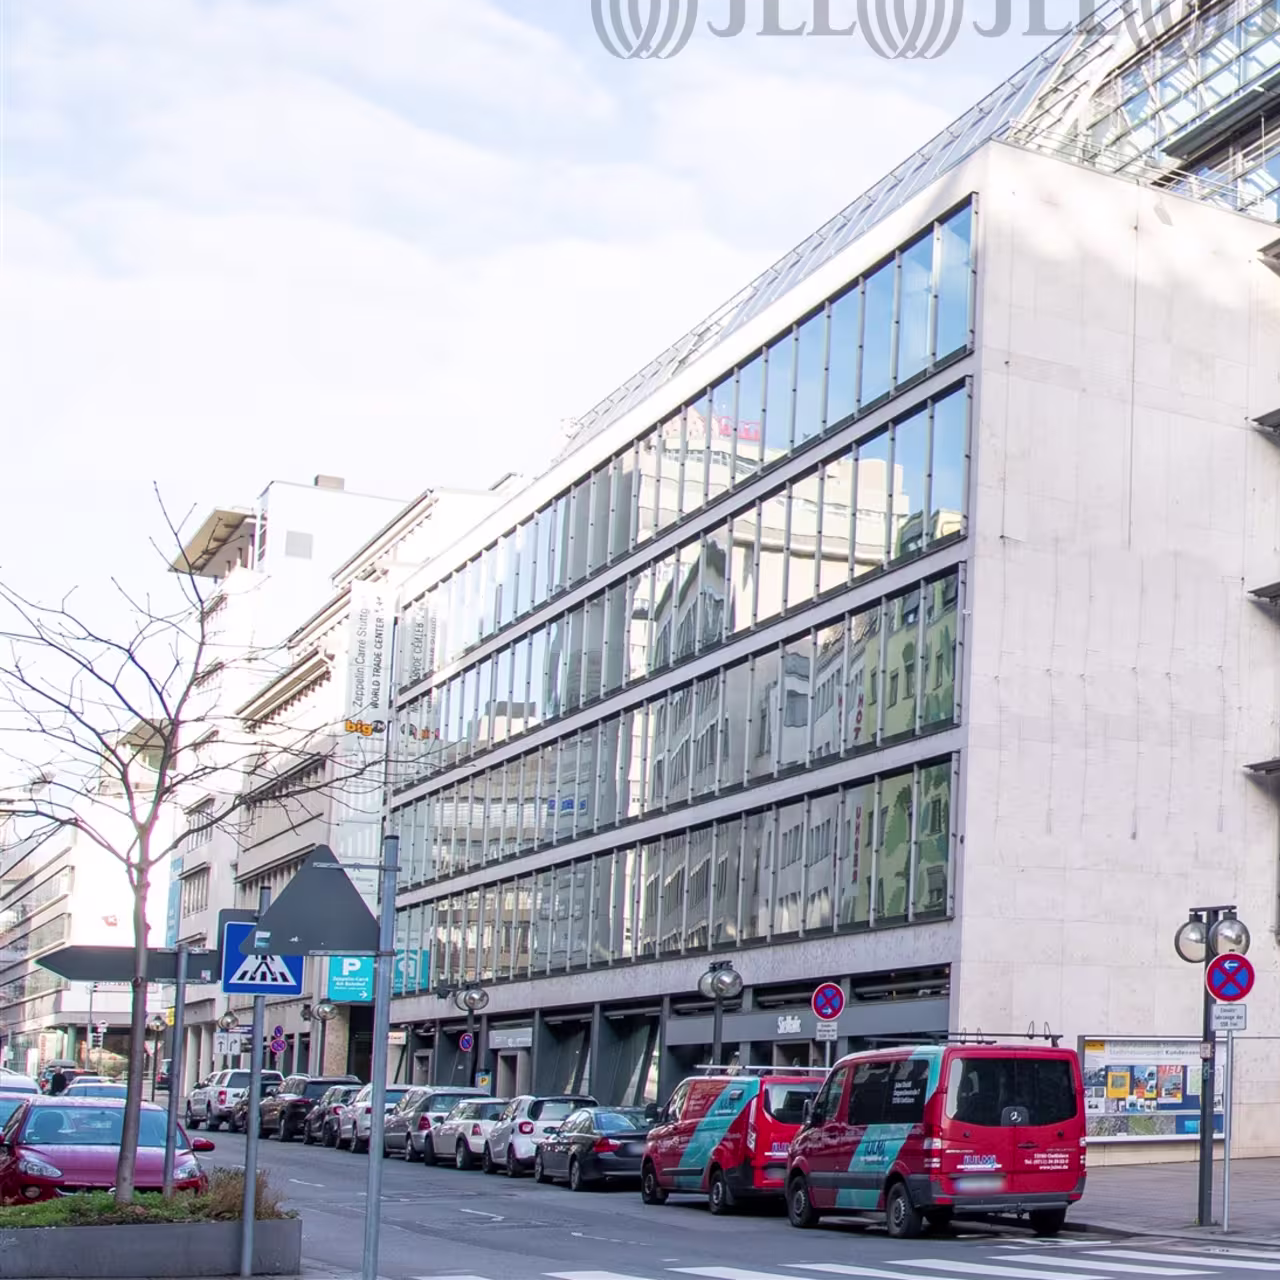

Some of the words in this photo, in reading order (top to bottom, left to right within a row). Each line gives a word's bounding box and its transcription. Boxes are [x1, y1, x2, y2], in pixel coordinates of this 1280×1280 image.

[357, 600, 370, 638] Stuttg
[375, 617, 386, 650] CENTER
[373, 653, 384, 678] TRADE
[353, 667, 365, 708] Zeppelin
[371, 680, 381, 709] WORLD
[342, 958, 361, 975] P
[1158, 1065, 1183, 1074] NEU
